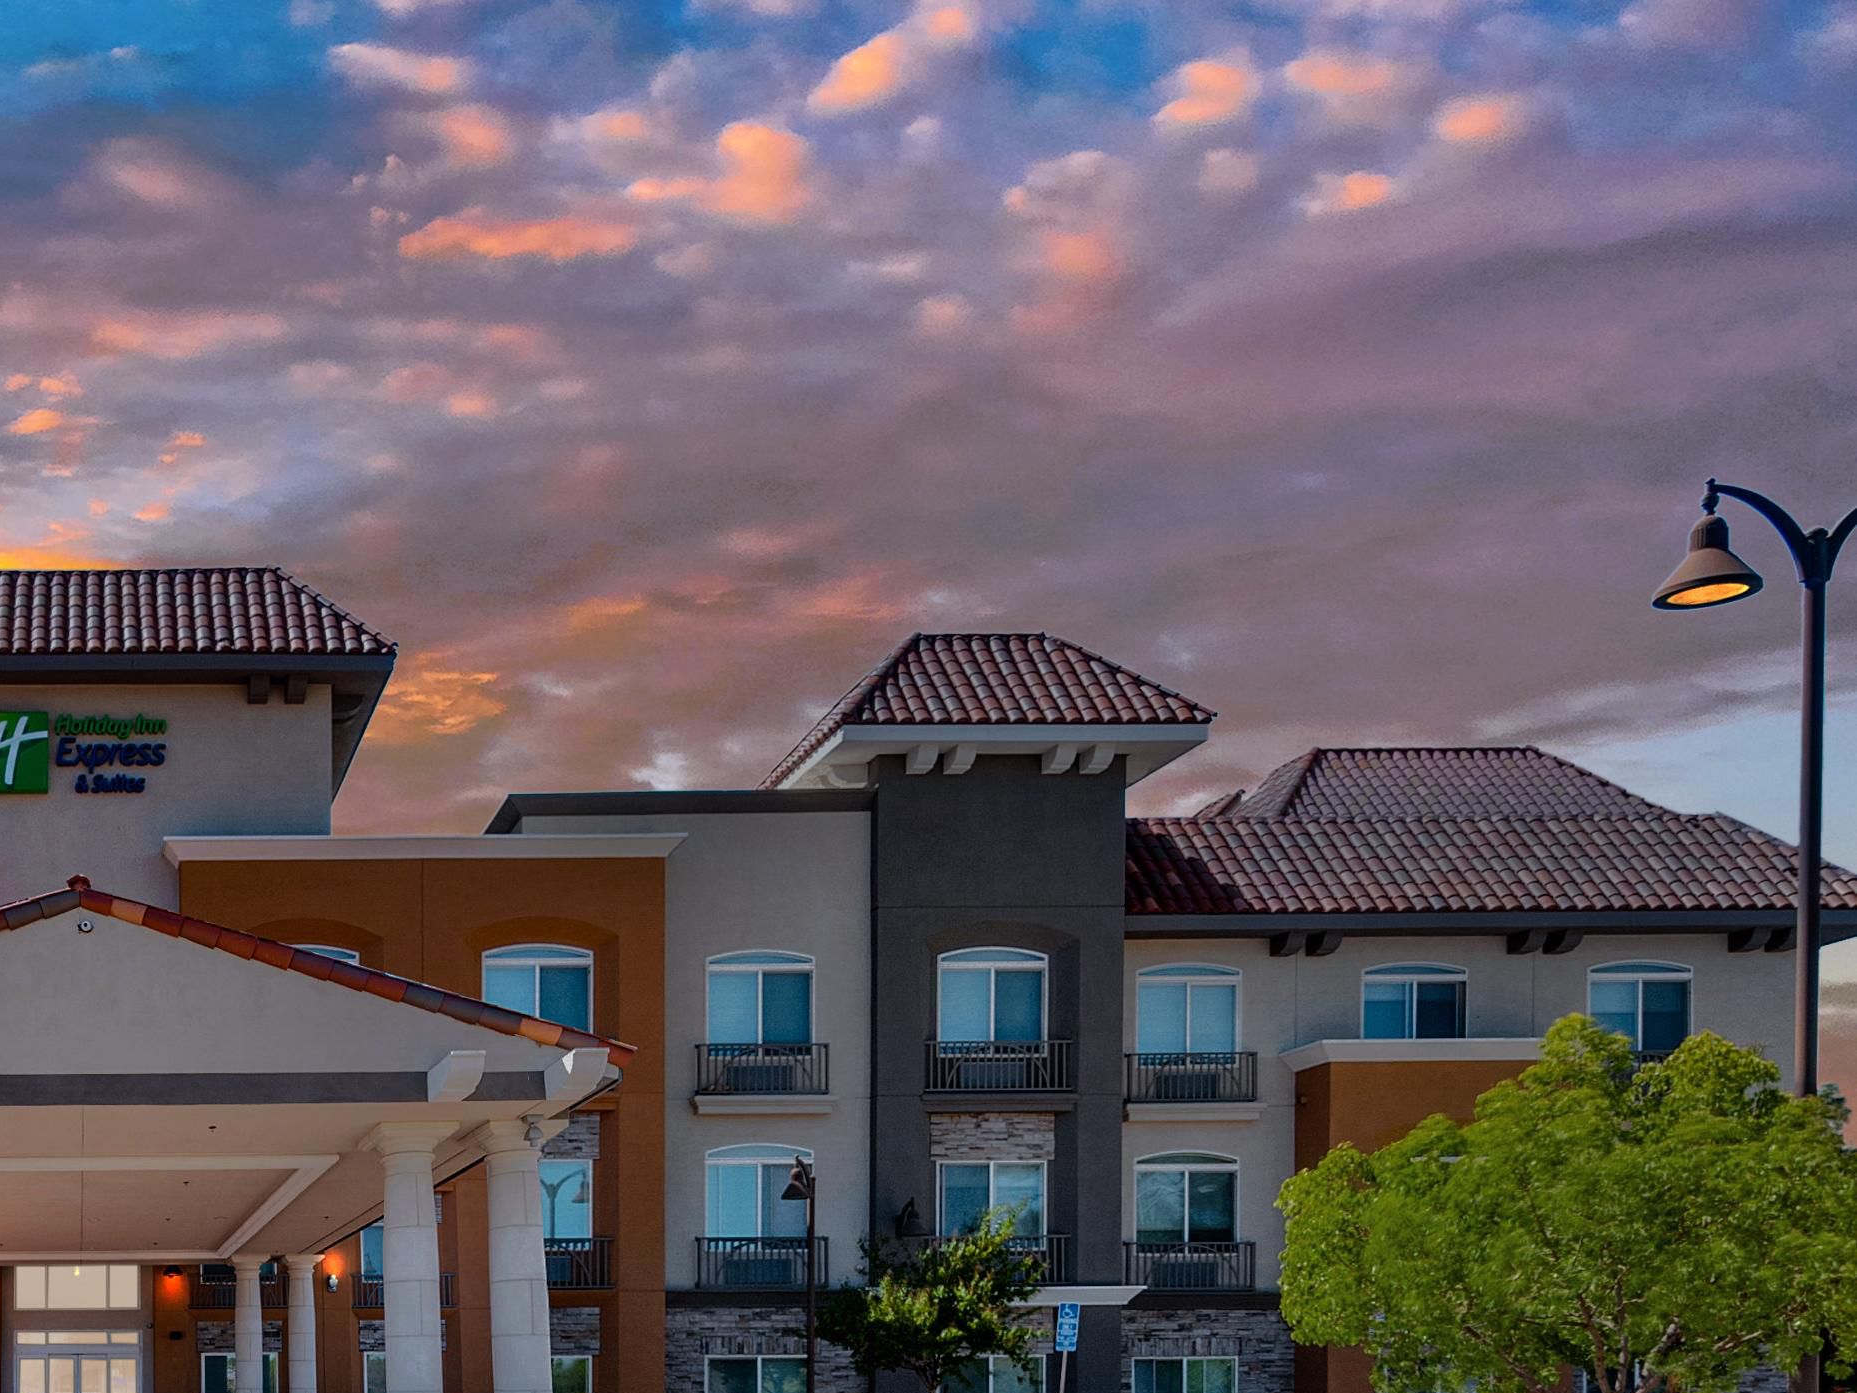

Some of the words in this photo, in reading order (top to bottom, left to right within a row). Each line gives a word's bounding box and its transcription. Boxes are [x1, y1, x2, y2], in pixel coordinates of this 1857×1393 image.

[55, 713, 133, 739] Holiday
[134, 713, 167, 735] Inn
[56, 737, 166, 774] Express
[75, 774, 89, 793] &
[91, 774, 146, 793] Suites
